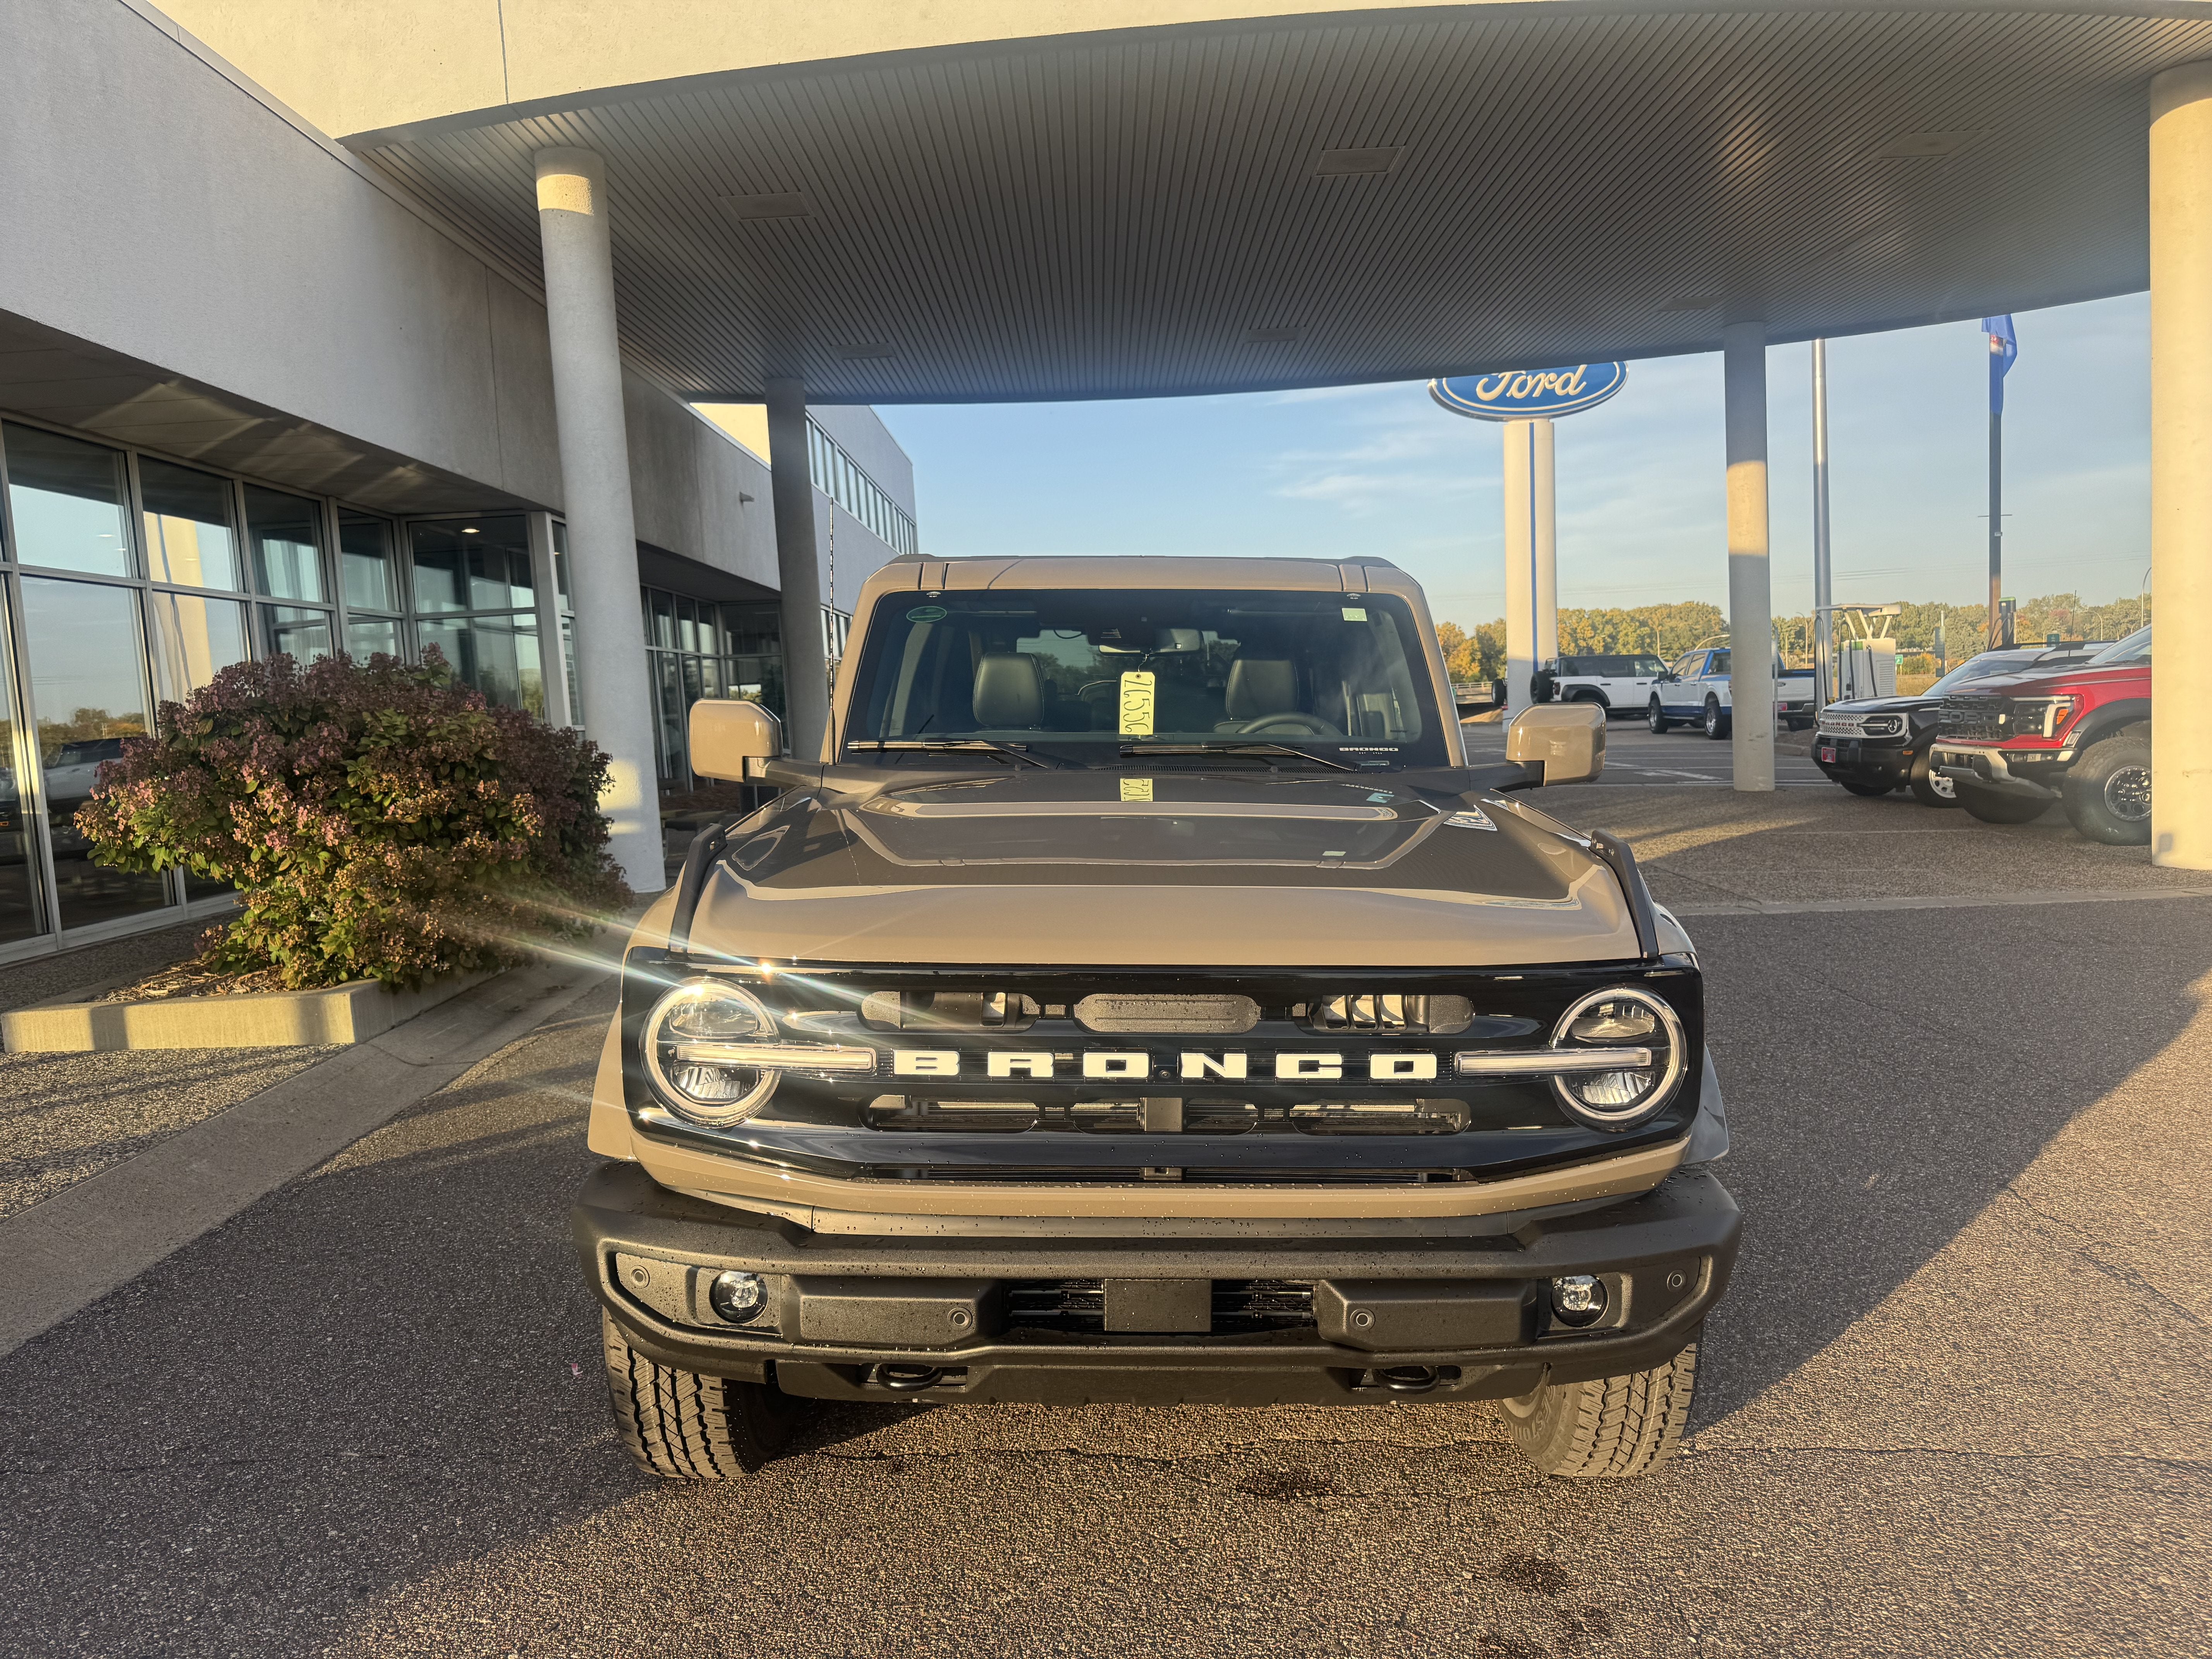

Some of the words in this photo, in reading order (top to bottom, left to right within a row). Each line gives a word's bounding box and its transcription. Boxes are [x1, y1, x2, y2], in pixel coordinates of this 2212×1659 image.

[1476, 364, 1587, 401] Ford
[1123, 680, 1152, 732] 26556
[894, 1050, 1437, 1079] BRONCO
